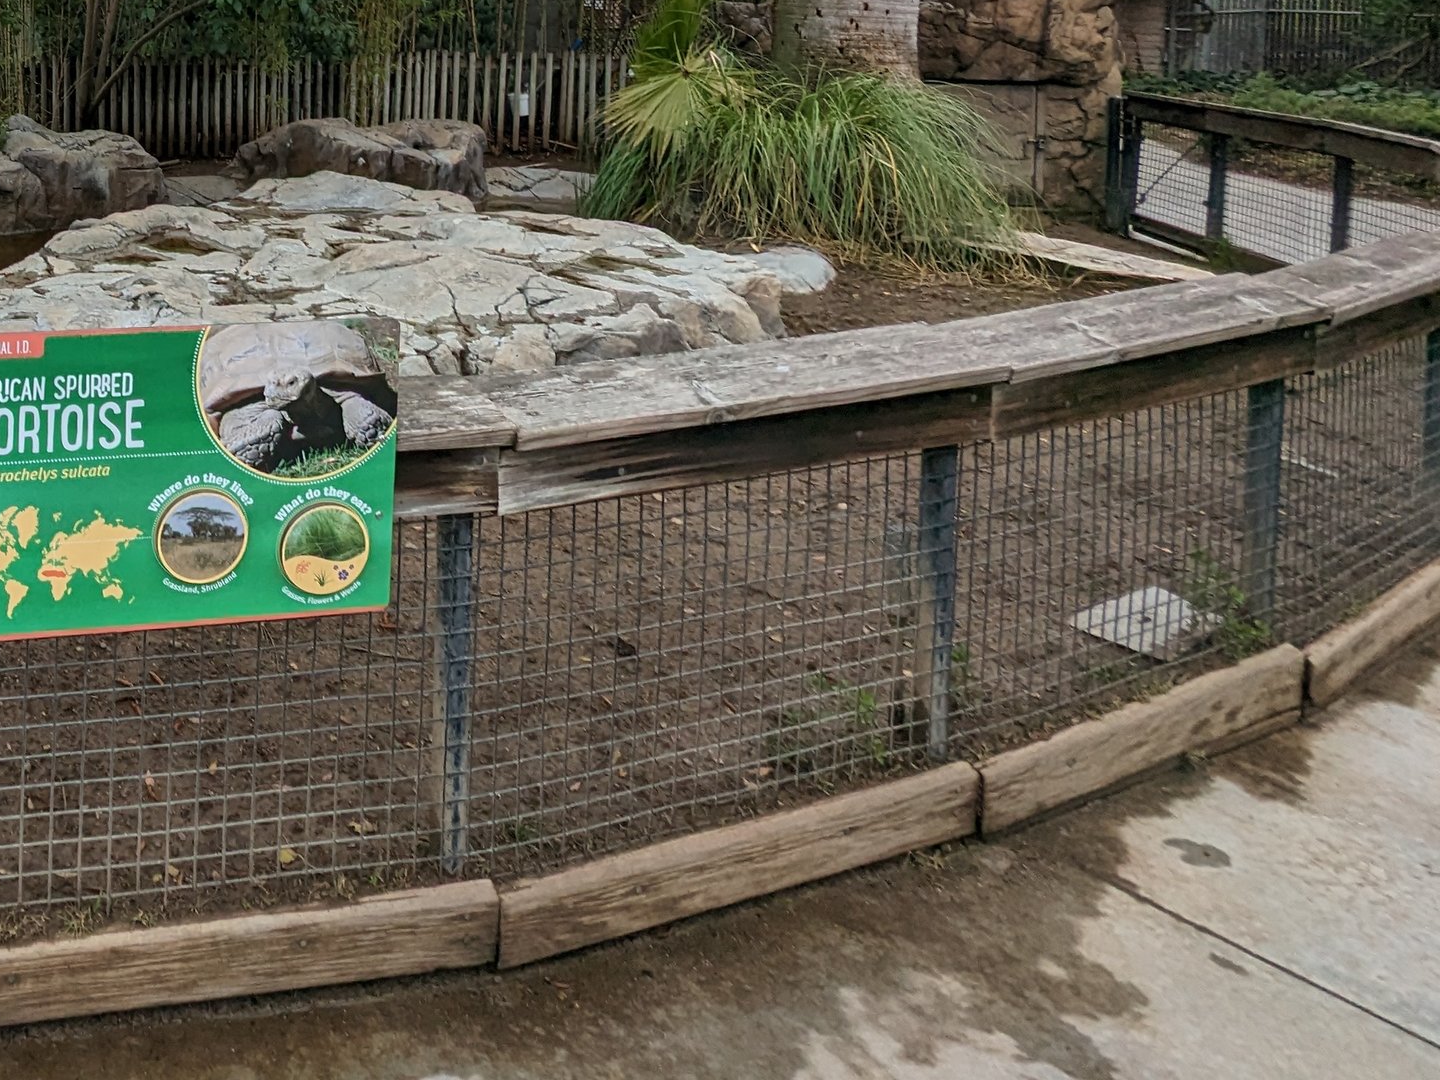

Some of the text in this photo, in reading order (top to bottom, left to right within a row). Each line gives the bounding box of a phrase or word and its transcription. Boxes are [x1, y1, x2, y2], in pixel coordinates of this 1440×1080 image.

[16, 340, 32, 354] I.D.
[61, 465, 111, 479] sulcata
[148, 472, 254, 512] Where do they live?
[274, 486, 373, 522] What do they eat?
[162, 571, 238, 595] Grassland, Shrubland
